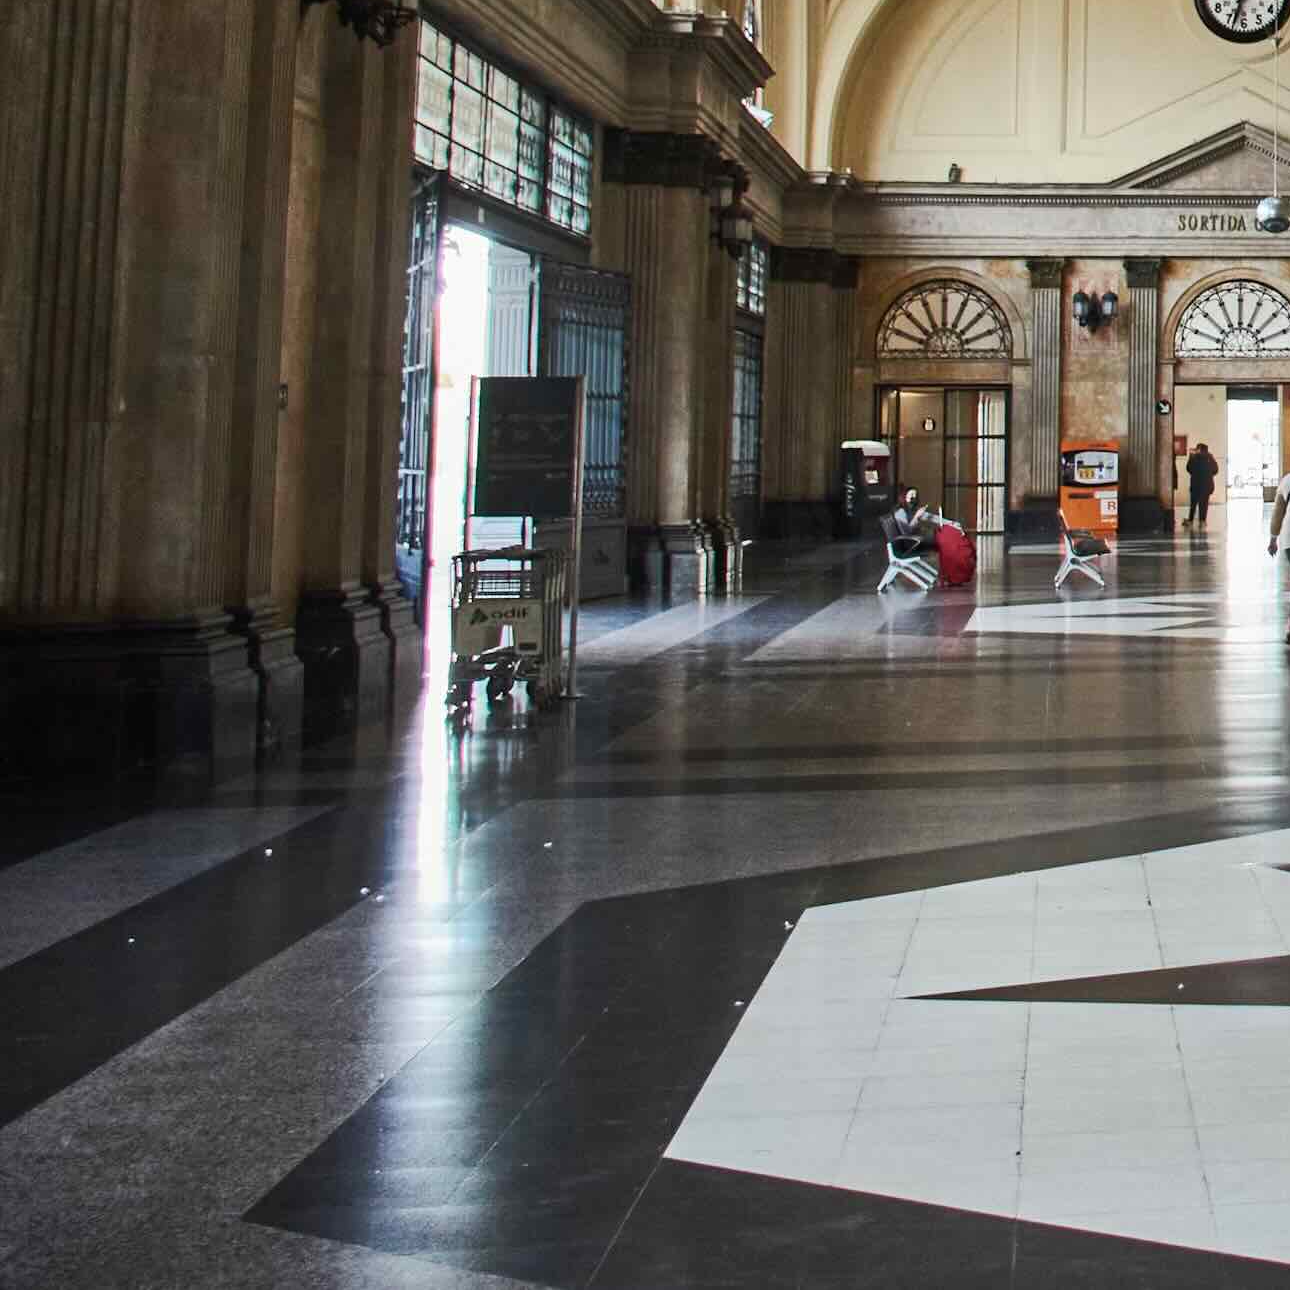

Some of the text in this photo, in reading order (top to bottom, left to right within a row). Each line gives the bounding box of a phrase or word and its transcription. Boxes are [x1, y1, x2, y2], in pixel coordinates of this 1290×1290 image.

[1215, 3, 1222, 13] 8
[1226, 14, 1232, 24] 7
[1240, 18, 1247, 29] 6
[1256, 14, 1262, 25] 5
[1178, 214, 1246, 231] SORTIDA
[1107, 501, 1116, 511] R
